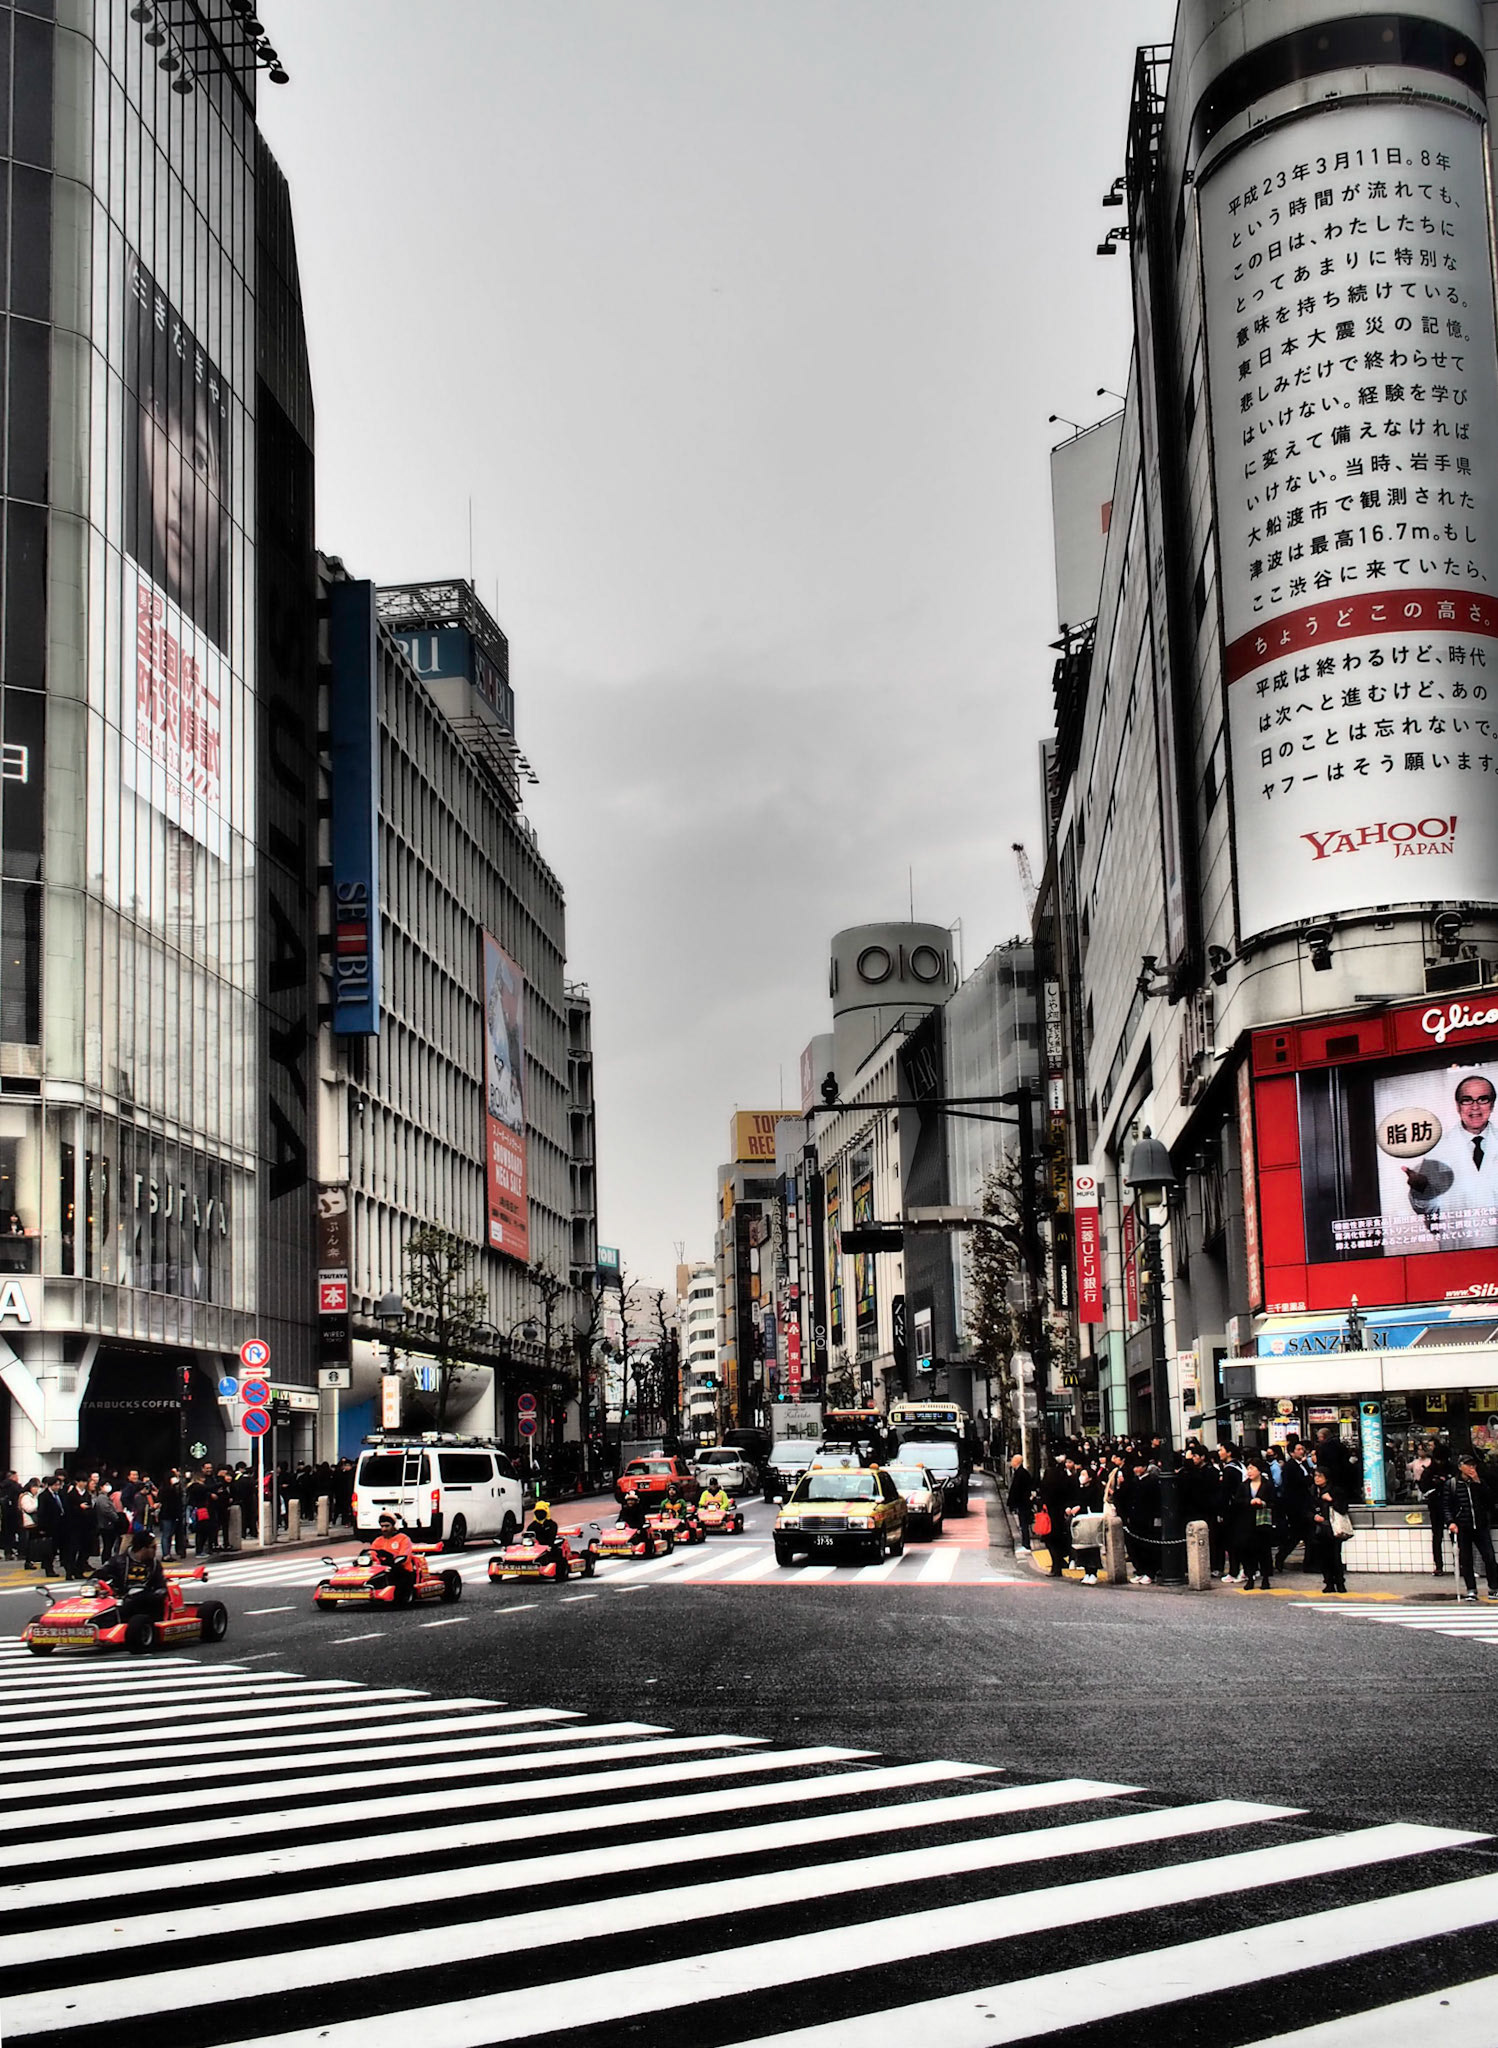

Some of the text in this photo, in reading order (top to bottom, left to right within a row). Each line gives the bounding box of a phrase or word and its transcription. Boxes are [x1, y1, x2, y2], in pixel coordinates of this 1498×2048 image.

[1228, 148, 1452, 216] 平成23年3月11日。8年
[1231, 181, 1461, 249] という時間が流れても、
[1233, 214, 1455, 281] この日は、わたしたちに
[1236, 248, 1457, 314] とってあまりに特別な
[1236, 281, 1469, 349] 意味を持ち続けている。
[1238, 315, 1471, 382] 東日本大震災の記憶。
[1240, 350, 1465, 414] 悲しみだけで終わらせて
[1242, 384, 1468, 447] はいけない。経験を学び
[1244, 419, 1470, 479] に変えて備えなければ
[1247, 453, 1472, 512] いけない。当時、岩手県
[1248, 487, 1475, 548] 大船渡市で観測された
[1249, 522, 1477, 582] 津波は最高16.7m。もし
[1252, 557, 1489, 613] ここ渋谷に来ていたら、
[1255, 600, 1491, 655] ちょうどこの高さ。
[1256, 645, 1487, 699] 平成は終わるけど、時代
[1258, 681, 1488, 734] は次へと進むけど、あの
[1260, 716, 1498, 768] 日のことは忘れないで。
[1299, 815, 1459, 862] YAHOO!
[1393, 841, 1455, 860] JAPAN
[336, 881, 368, 1003] SEIBU
[1385, 1119, 1433, 1146] 脂肪
[134, 1173, 227, 1235] TSUTAYA
[772, 1196, 783, 1262] KARAOKE
[319, 1272, 348, 1280] TSUTAYA
[1080, 1216, 1097, 1303] 三菱UFJ銀行
[323, 1286, 343, 1307] 本
[1266, 1302, 1306, 1313] 三千里薬品
[323, 1330, 345, 1338] WIRED
